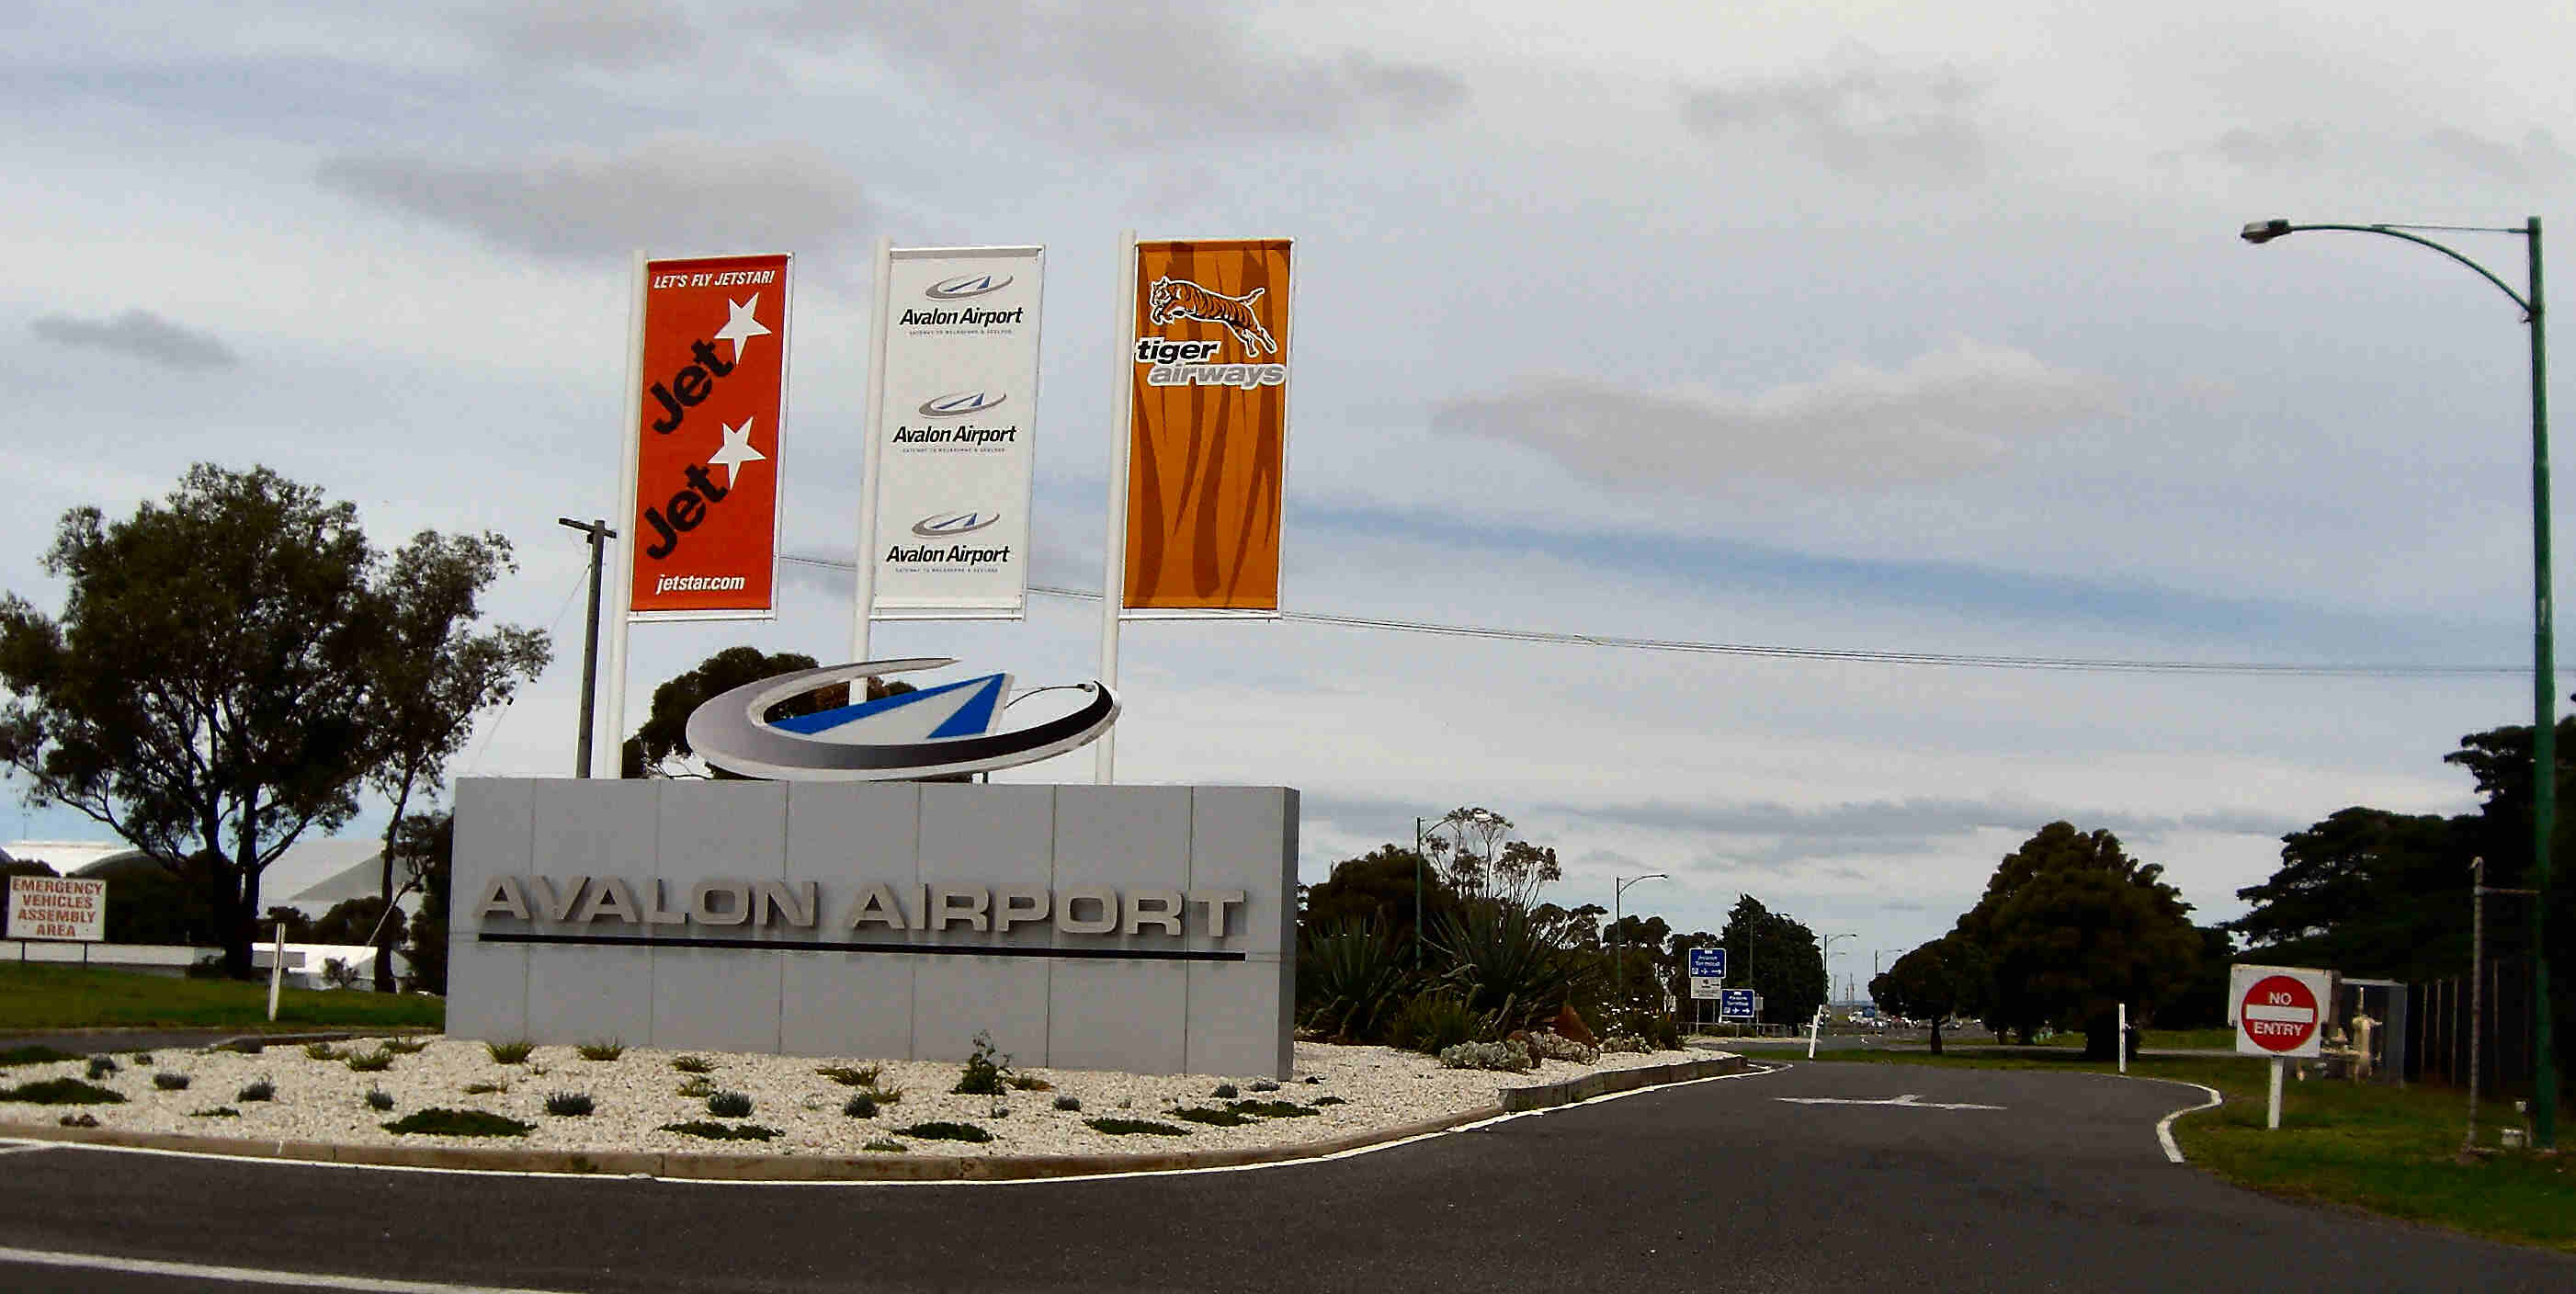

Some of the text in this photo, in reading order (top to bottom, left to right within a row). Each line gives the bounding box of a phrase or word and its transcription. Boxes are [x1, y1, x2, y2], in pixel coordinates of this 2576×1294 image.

[654, 270, 776, 289] LET'S FLY JETSTAR!
[899, 307, 1024, 328] Avalon Airport
[1137, 339, 1220, 366] tiger
[650, 338, 734, 435] Jet
[1148, 363, 1286, 389] airways
[892, 425, 1017, 446] Avalon Airport
[644, 463, 729, 561] Jet
[886, 545, 1011, 566] Avalon Airport
[655, 573, 746, 596] jetstar.com
[11, 879, 103, 895] EMERGENCY
[22, 894, 94, 909] VEHICLES
[474, 875, 1247, 937] AVALON AIRPORT
[17, 909, 96, 924] ASSEMBLY
[36, 924, 75, 936] AREA
[2269, 992, 2293, 1005] NO
[2253, 1021, 2304, 1037] ENTRY
